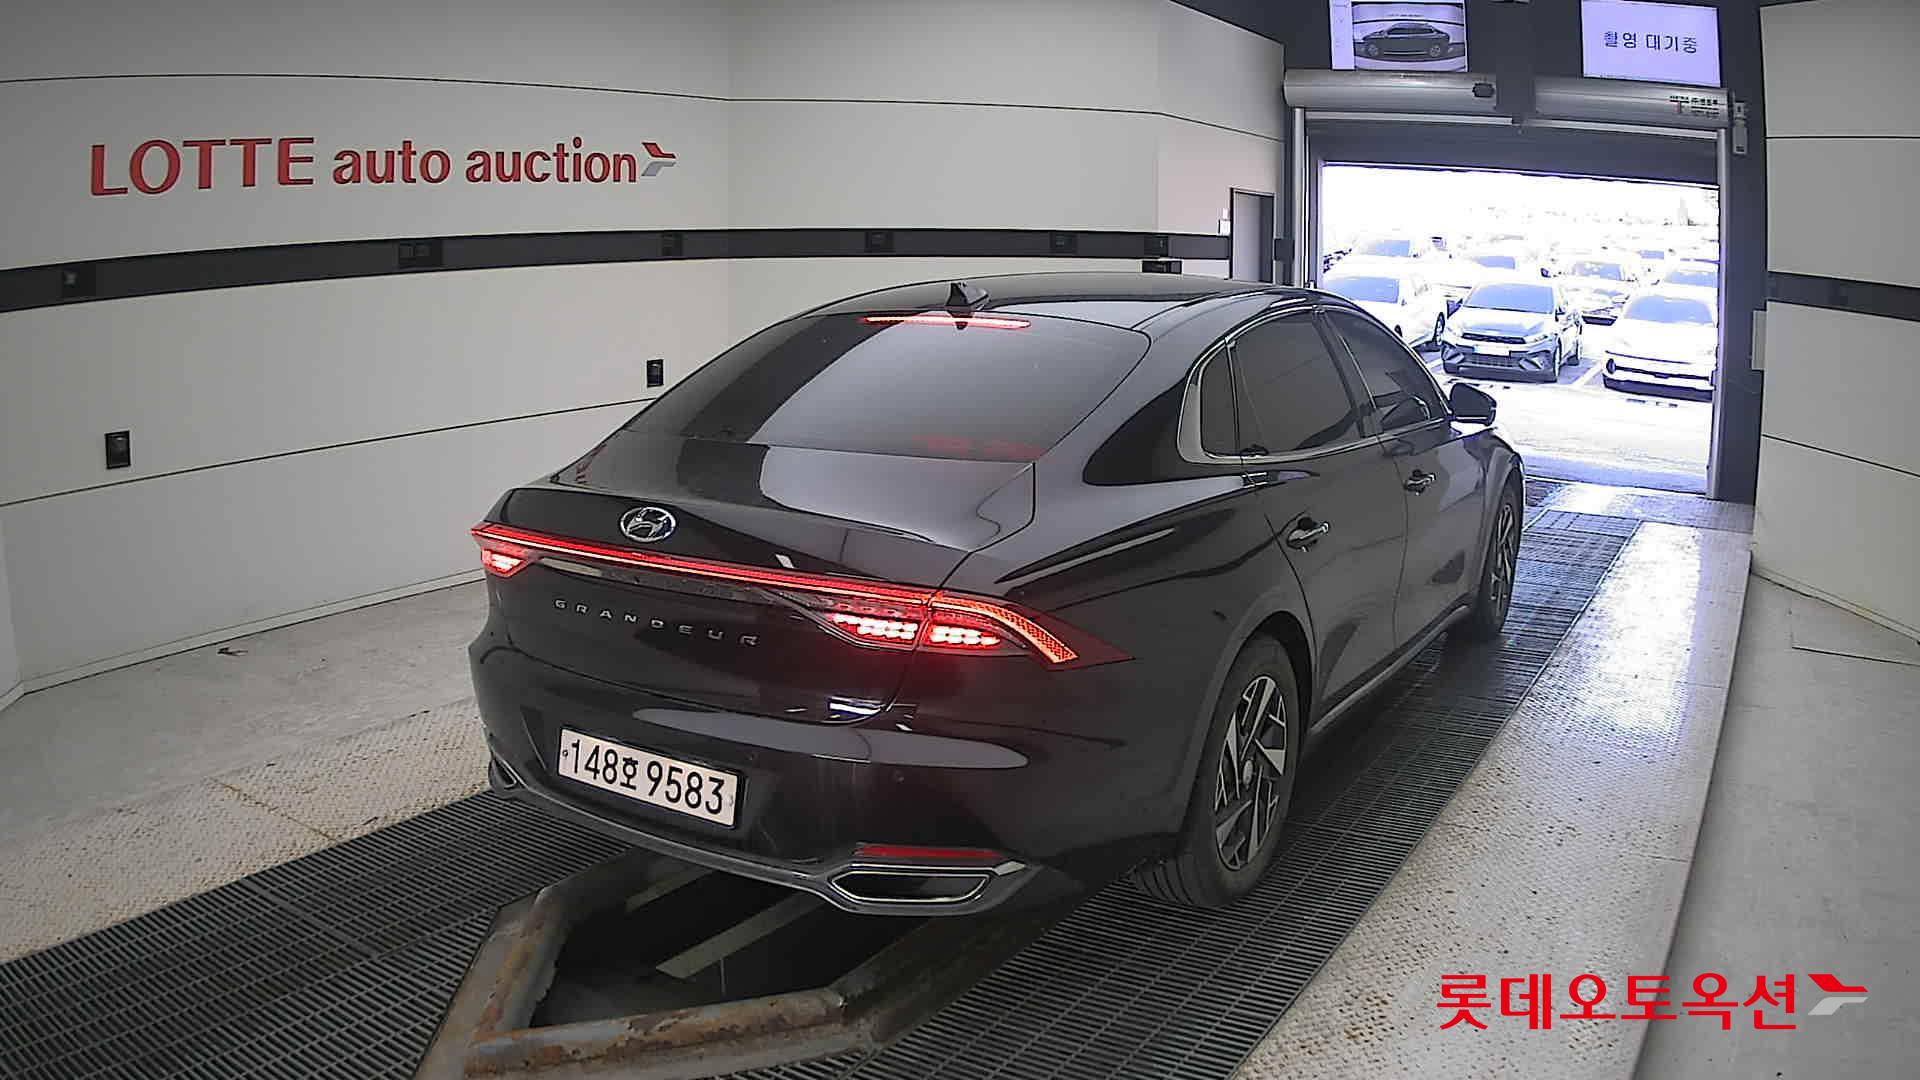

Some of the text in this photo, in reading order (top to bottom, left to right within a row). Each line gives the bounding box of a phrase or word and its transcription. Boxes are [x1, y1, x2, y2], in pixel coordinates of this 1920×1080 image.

[91, 136, 637, 196] LOTTE auto auction
[554, 599, 758, 646] GRANDEUR
[571, 739, 726, 815] 148호 9583
